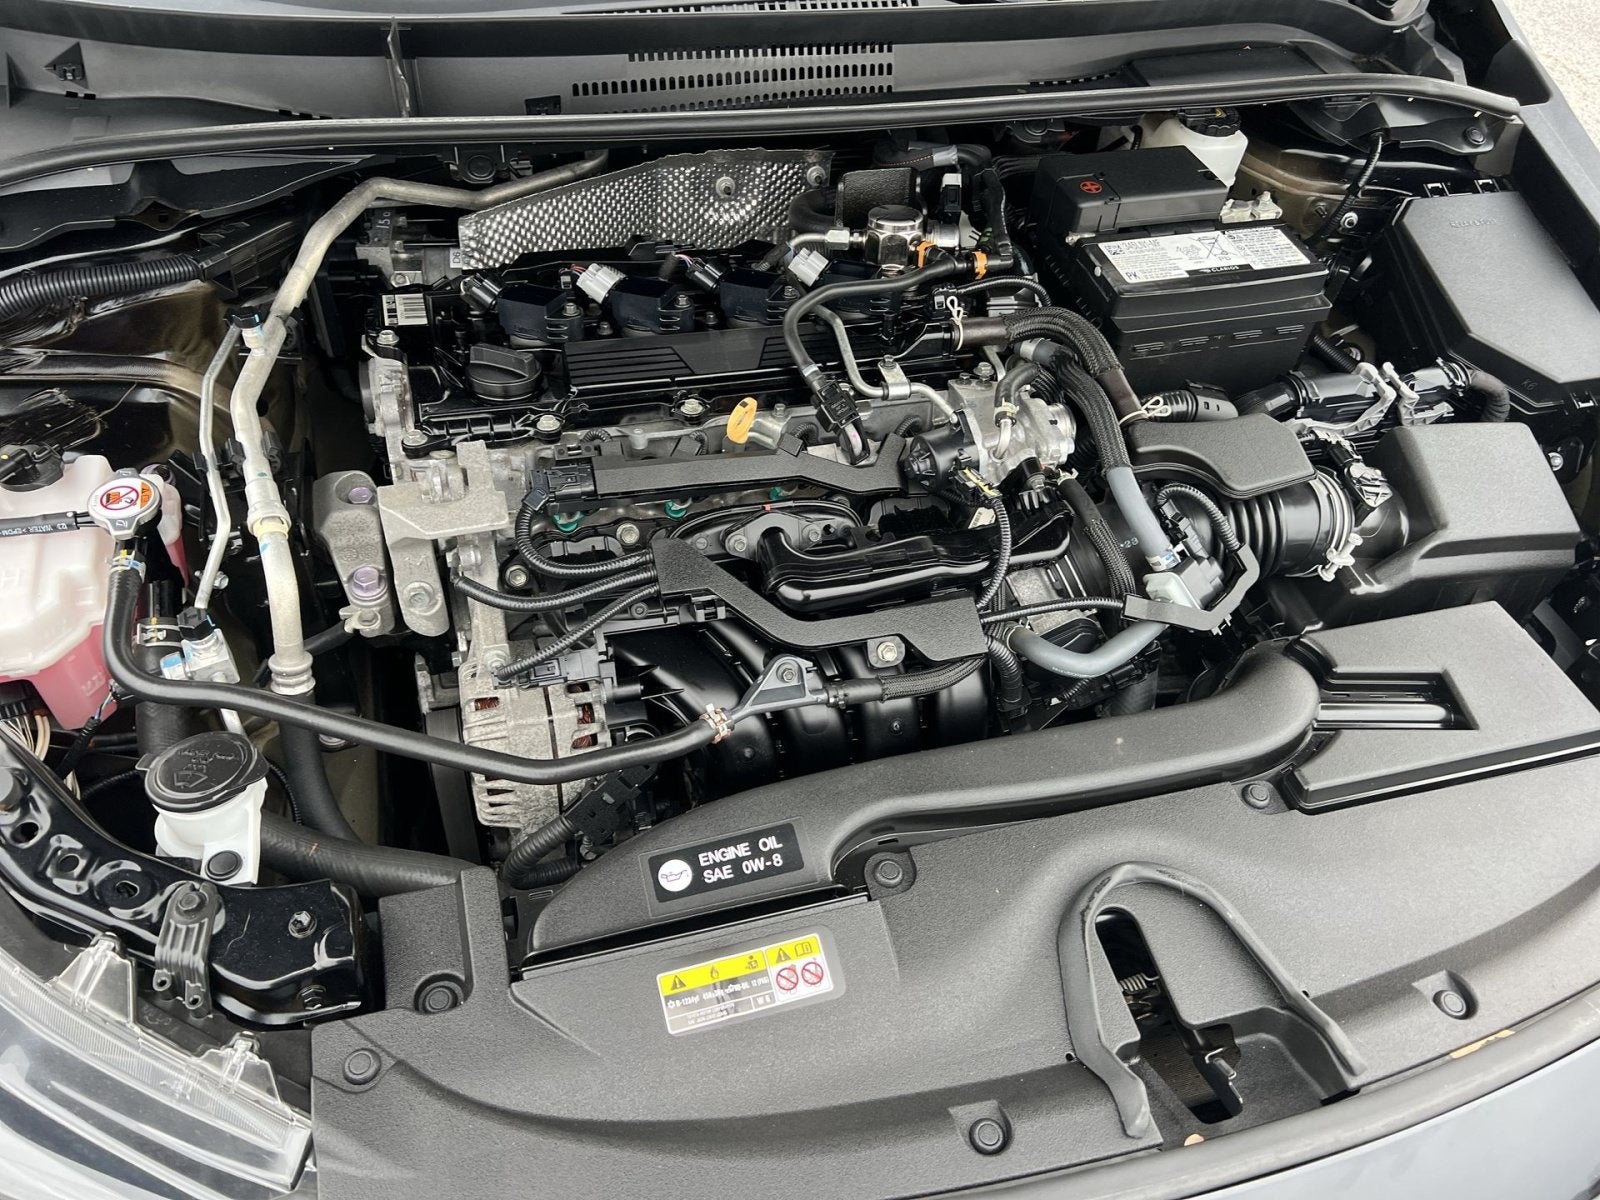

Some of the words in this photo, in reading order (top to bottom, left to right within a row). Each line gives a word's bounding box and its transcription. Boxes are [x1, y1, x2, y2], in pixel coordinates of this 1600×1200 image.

[0, 527, 26, 536] >EPDM
[28, 524, 53, 533] WATER
[698, 842, 751, 867] ENGINE
[758, 835, 783, 852] OIL
[702, 866, 734, 884] SAE
[742, 853, 783, 875] 0W-8
